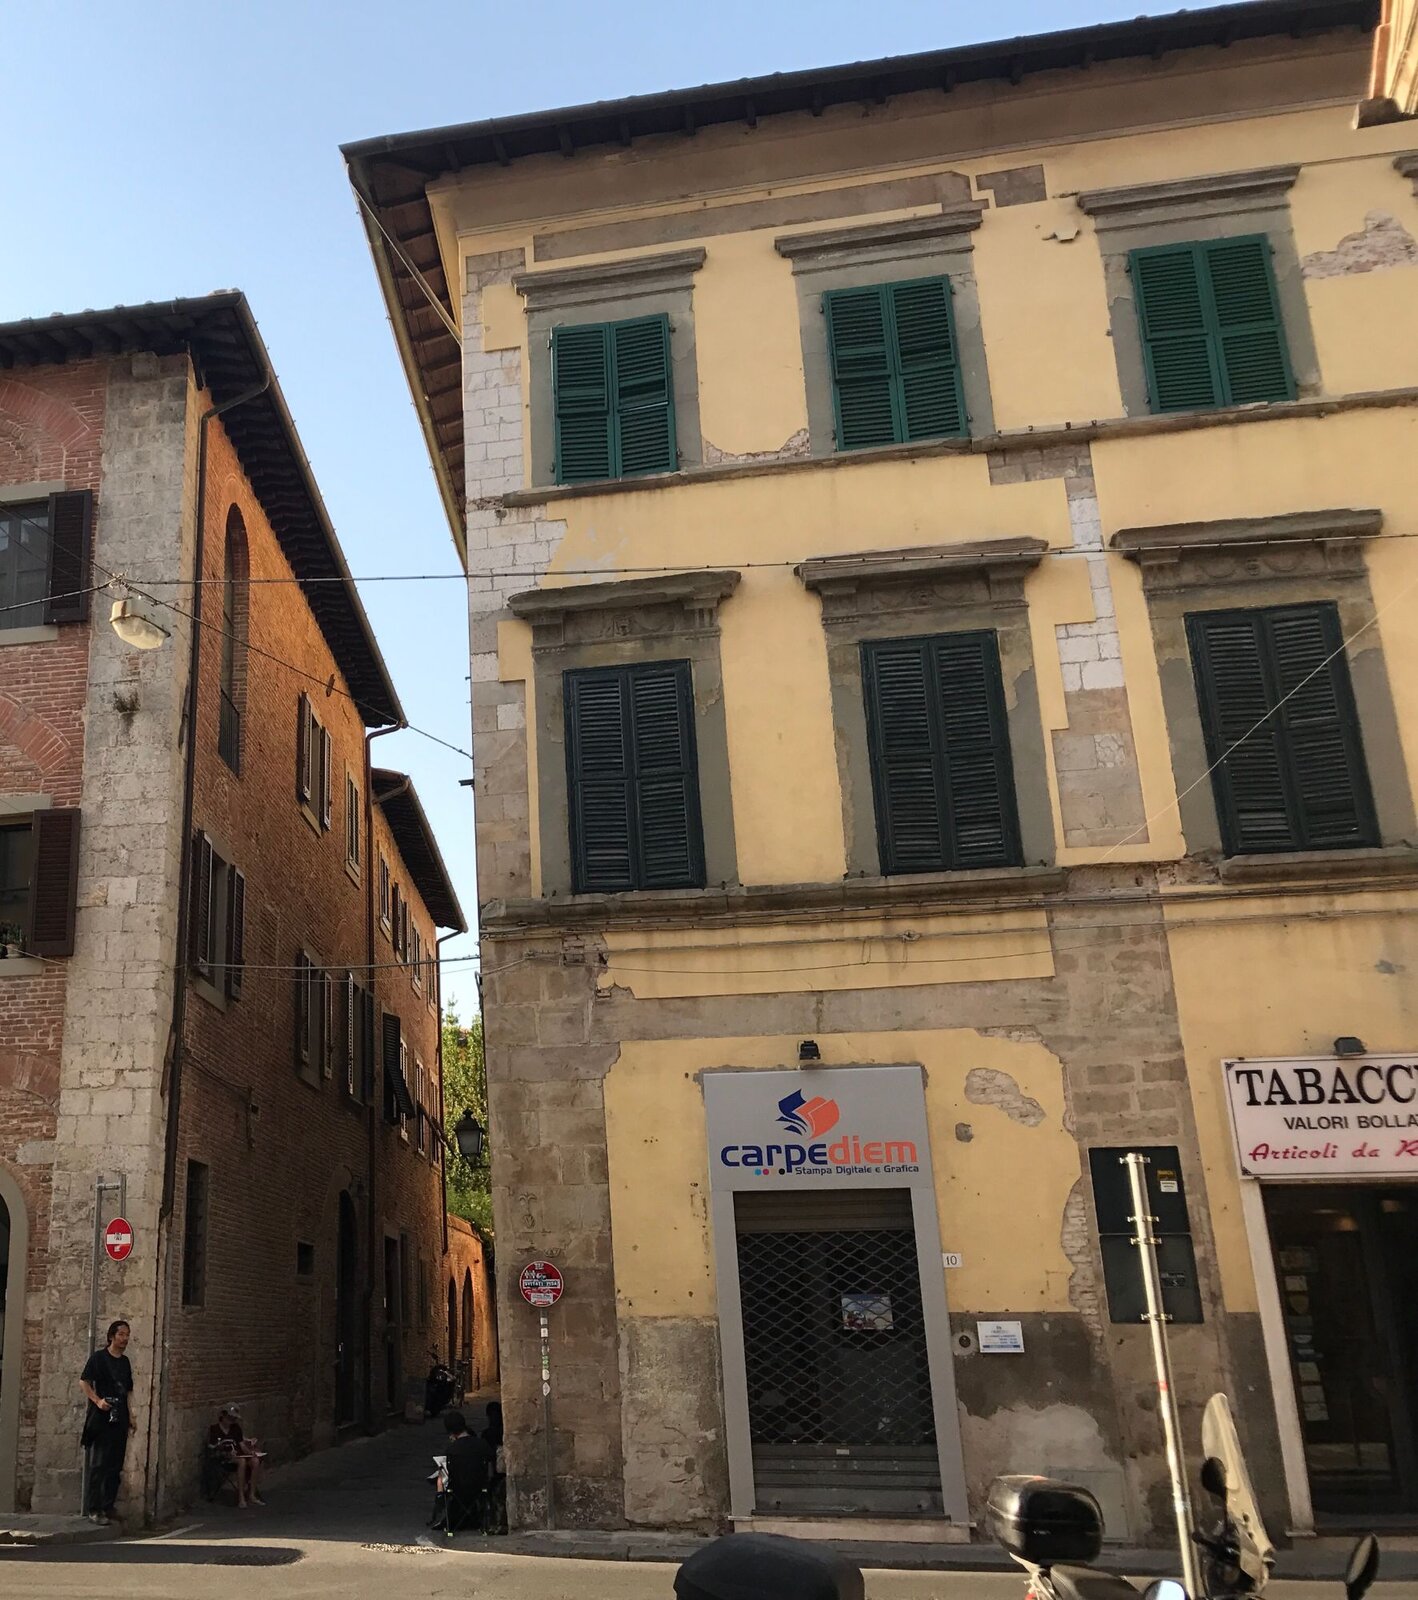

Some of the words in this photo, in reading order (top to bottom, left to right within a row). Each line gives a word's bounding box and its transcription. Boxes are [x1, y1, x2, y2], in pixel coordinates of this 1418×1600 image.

[1235, 1064, 1418, 1106] TABACC
[1283, 1116, 1349, 1130] VALORI
[1357, 1114, 1418, 1129] BOLLA
[721, 1136, 918, 1173] carpediem
[1249, 1143, 1338, 1162] Articoli
[1352, 1142, 1380, 1158] da
[795, 1166, 832, 1176] Stampa
[836, 1165, 872, 1176] Digitale
[884, 1164, 919, 1174] Grafica
[946, 1255, 957, 1266] 10
